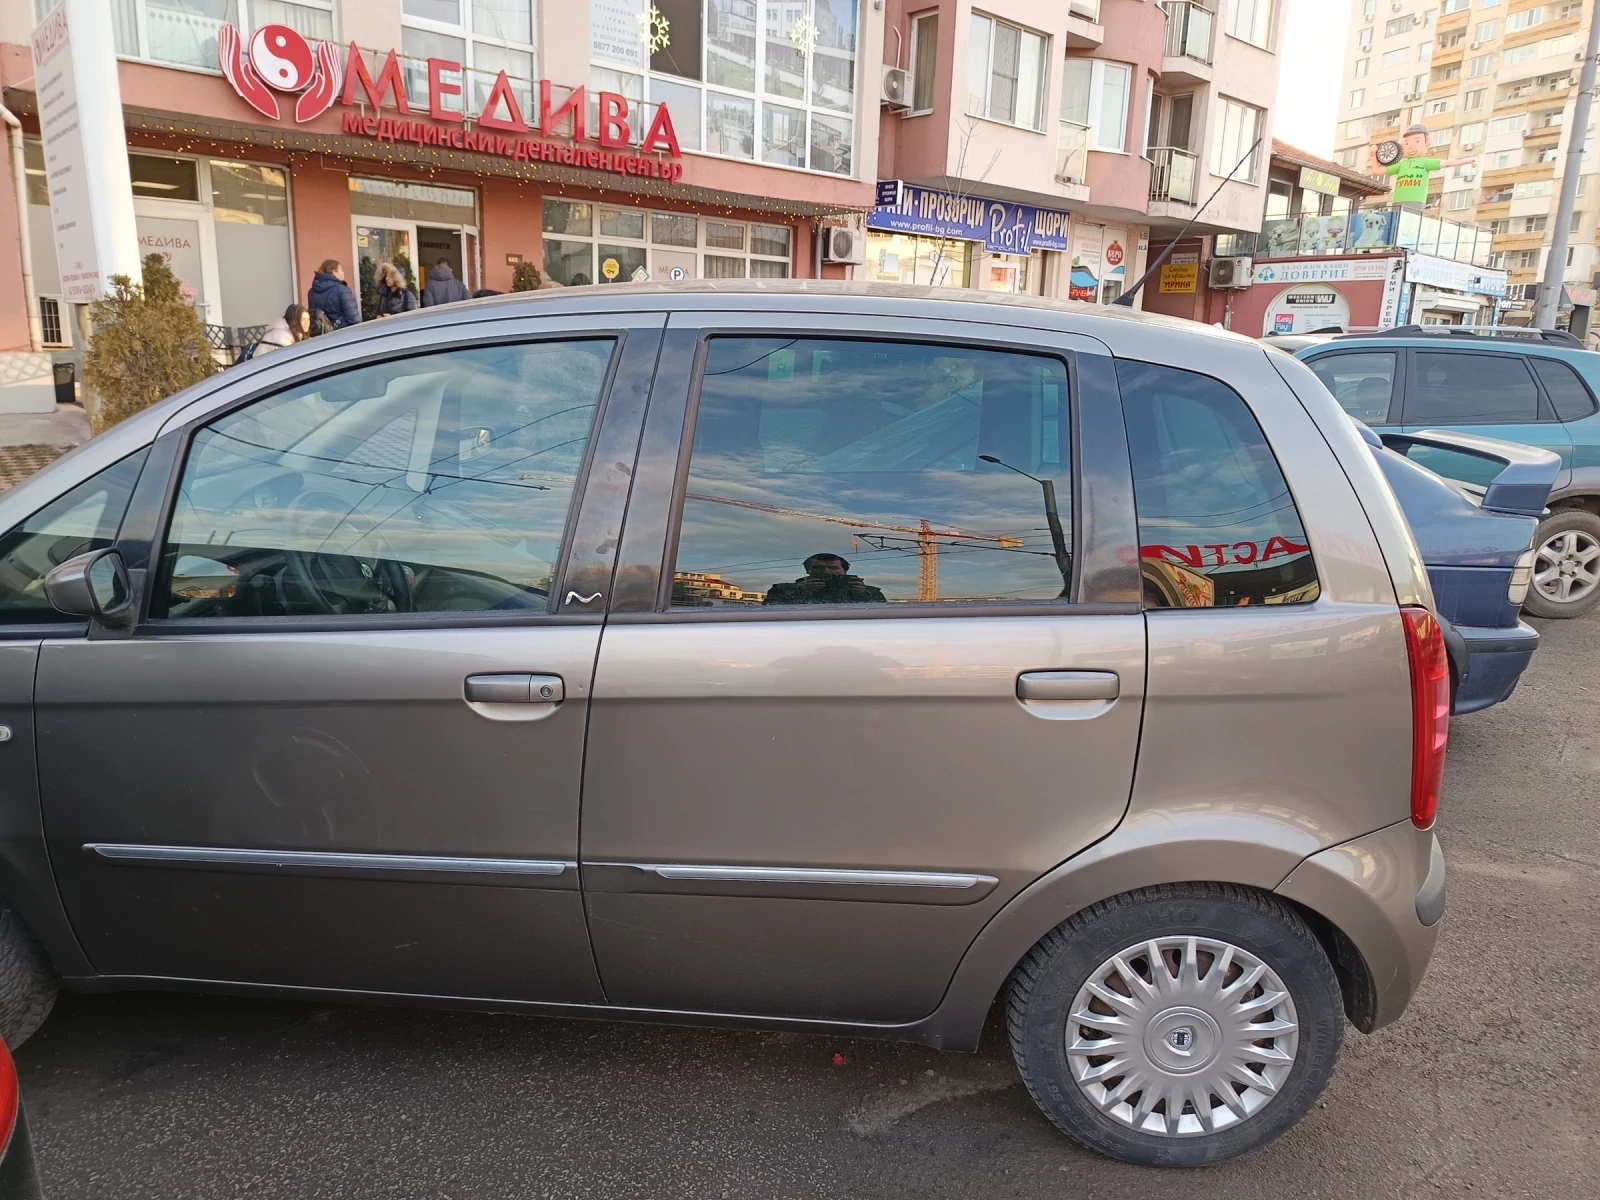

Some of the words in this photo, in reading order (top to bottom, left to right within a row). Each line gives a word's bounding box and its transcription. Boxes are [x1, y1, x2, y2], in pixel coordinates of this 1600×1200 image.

[593, 41, 610, 51] 0877
[612, 45, 624, 55] 200
[626, 49, 638, 58] 091
[342, 40, 682, 159] МЕДИВА
[342, 112, 494, 151] медицински
[495, 135, 510, 156] и
[512, 138, 612, 170] дентален
[612, 153, 683, 185] център
[919, 189, 984, 229] ПРОЗОРЦИ
[890, 220, 963, 236] www.profil-bgcom
[989, 203, 1032, 254] Profil
[1035, 209, 1069, 238] ЩОРИ
[138, 236, 191, 248] МЕДИВА
[674, 270, 681, 280] P
[1280, 263, 1321, 271] ЗАЛОЖНИ
[1280, 269, 1349, 281] ДОВЕРИЕ
[1316, 294, 1333, 304] WU
[1276, 315, 1293, 323] Easy
